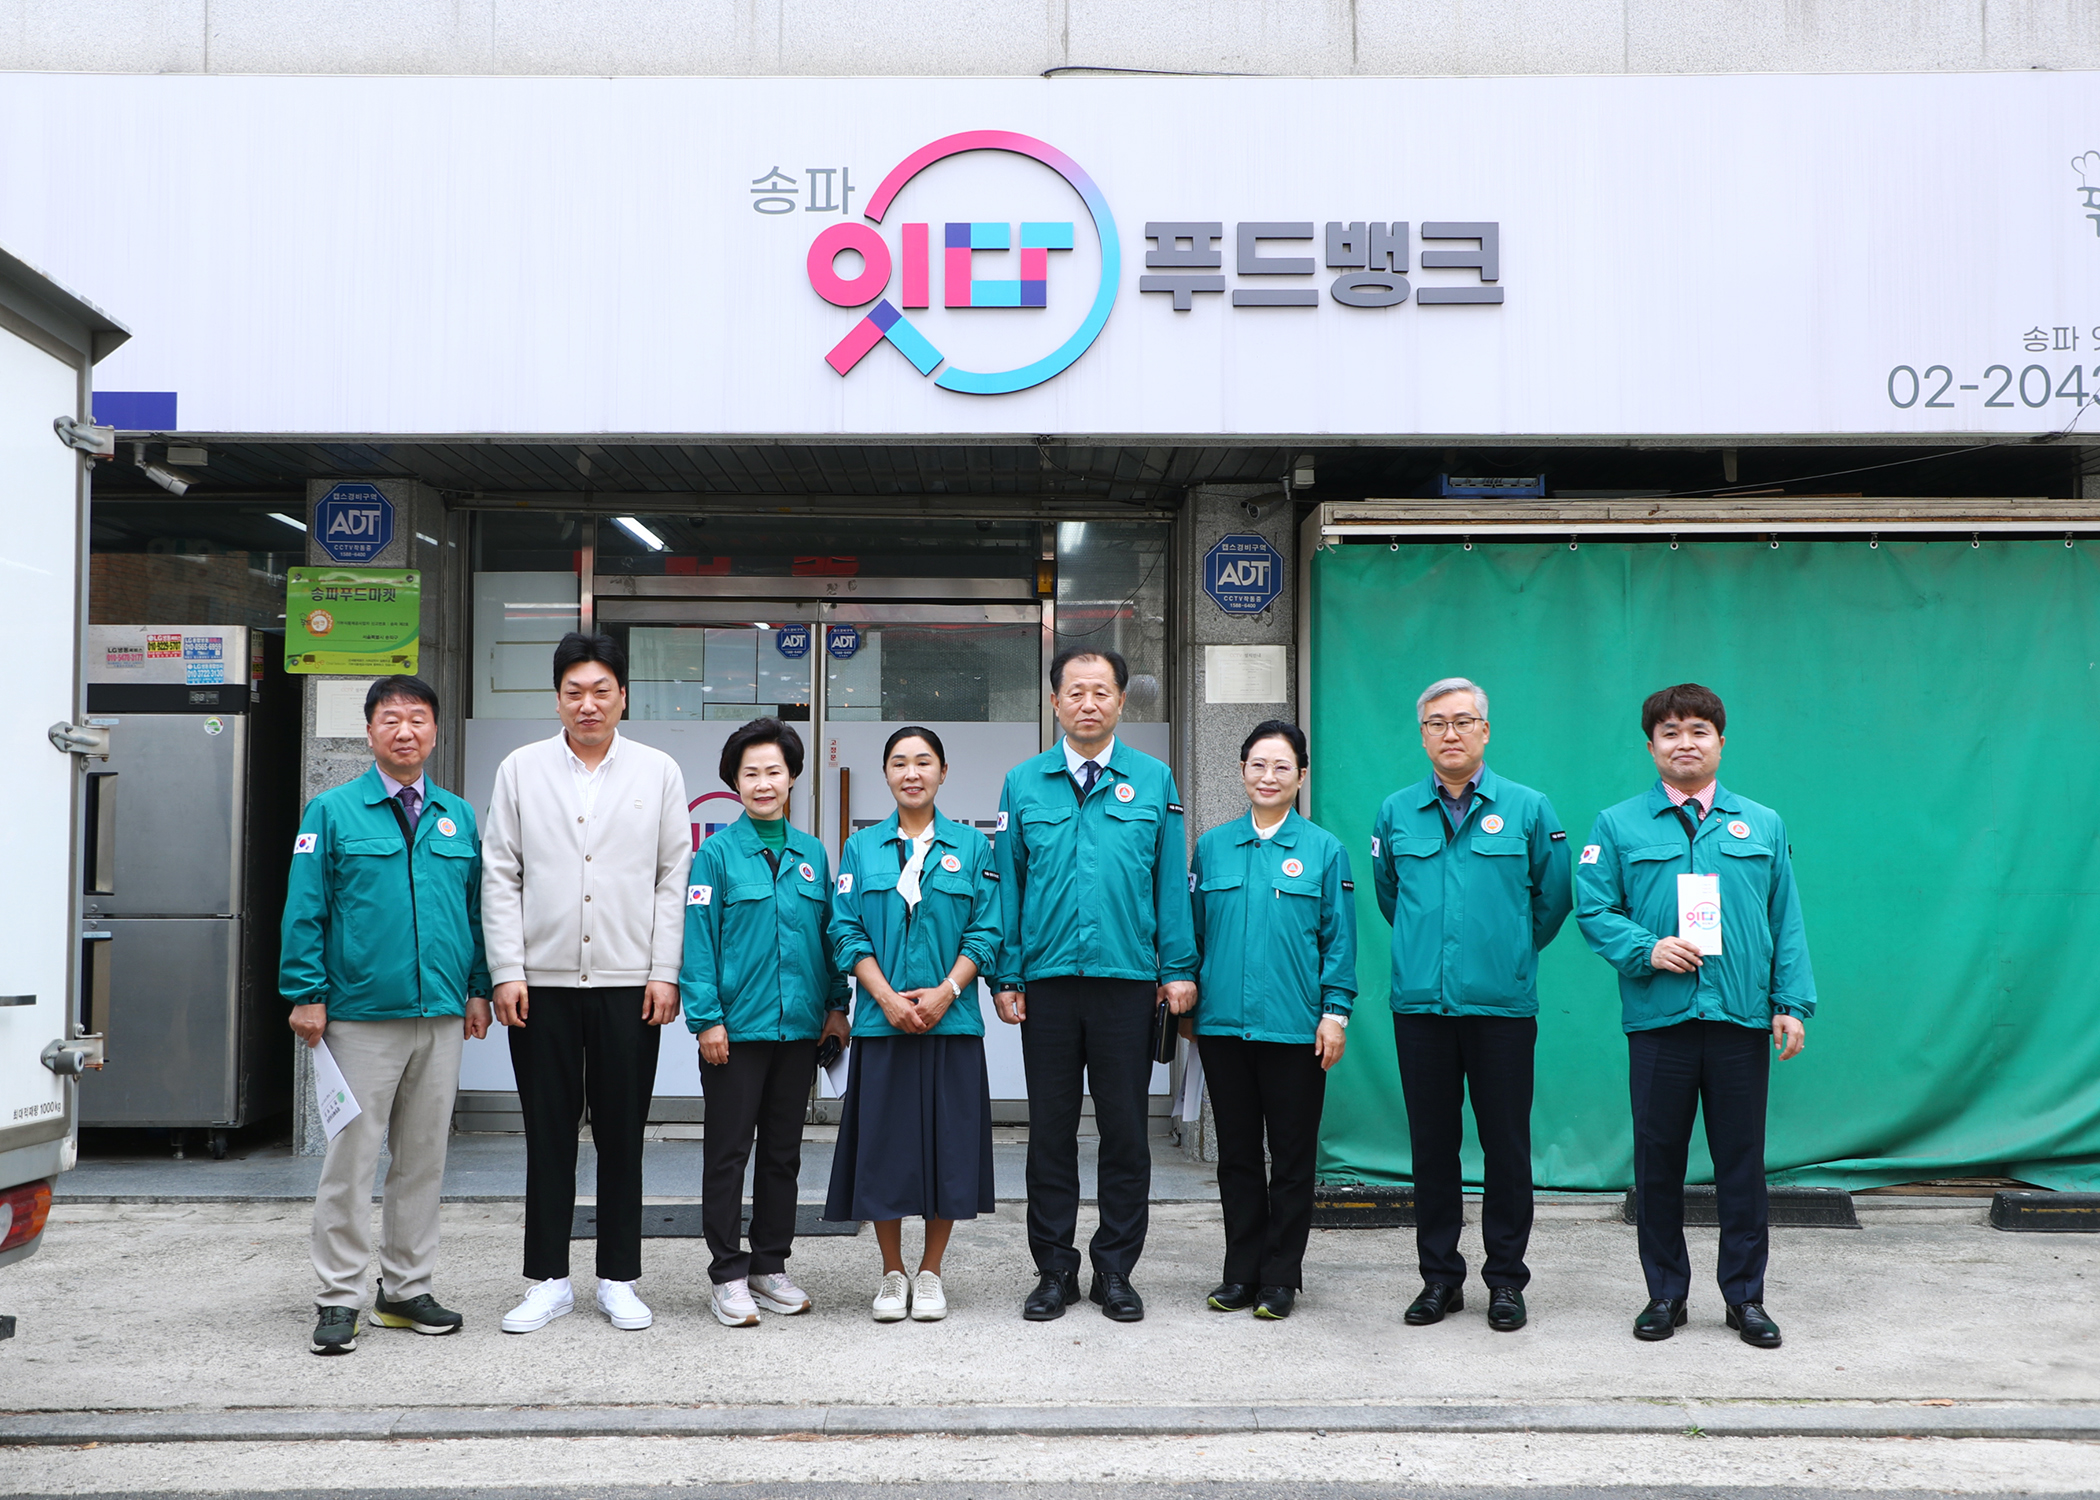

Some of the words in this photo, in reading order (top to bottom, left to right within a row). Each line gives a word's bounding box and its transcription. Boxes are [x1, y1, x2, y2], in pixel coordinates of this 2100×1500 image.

[750, 165, 856, 216] 송파
[806, 221, 1075, 377] 잇다
[1139, 221, 1505, 312] 푸드뱅크
[2022, 326, 2080, 352] 송파
[1887, 364, 2100, 409] 02-204
[328, 509, 380, 535] ADT
[1217, 560, 1270, 587] ADT
[311, 586, 397, 603] 송파푸드마켓
[781, 634, 806, 648] ADT
[831, 635, 856, 648] ADT
